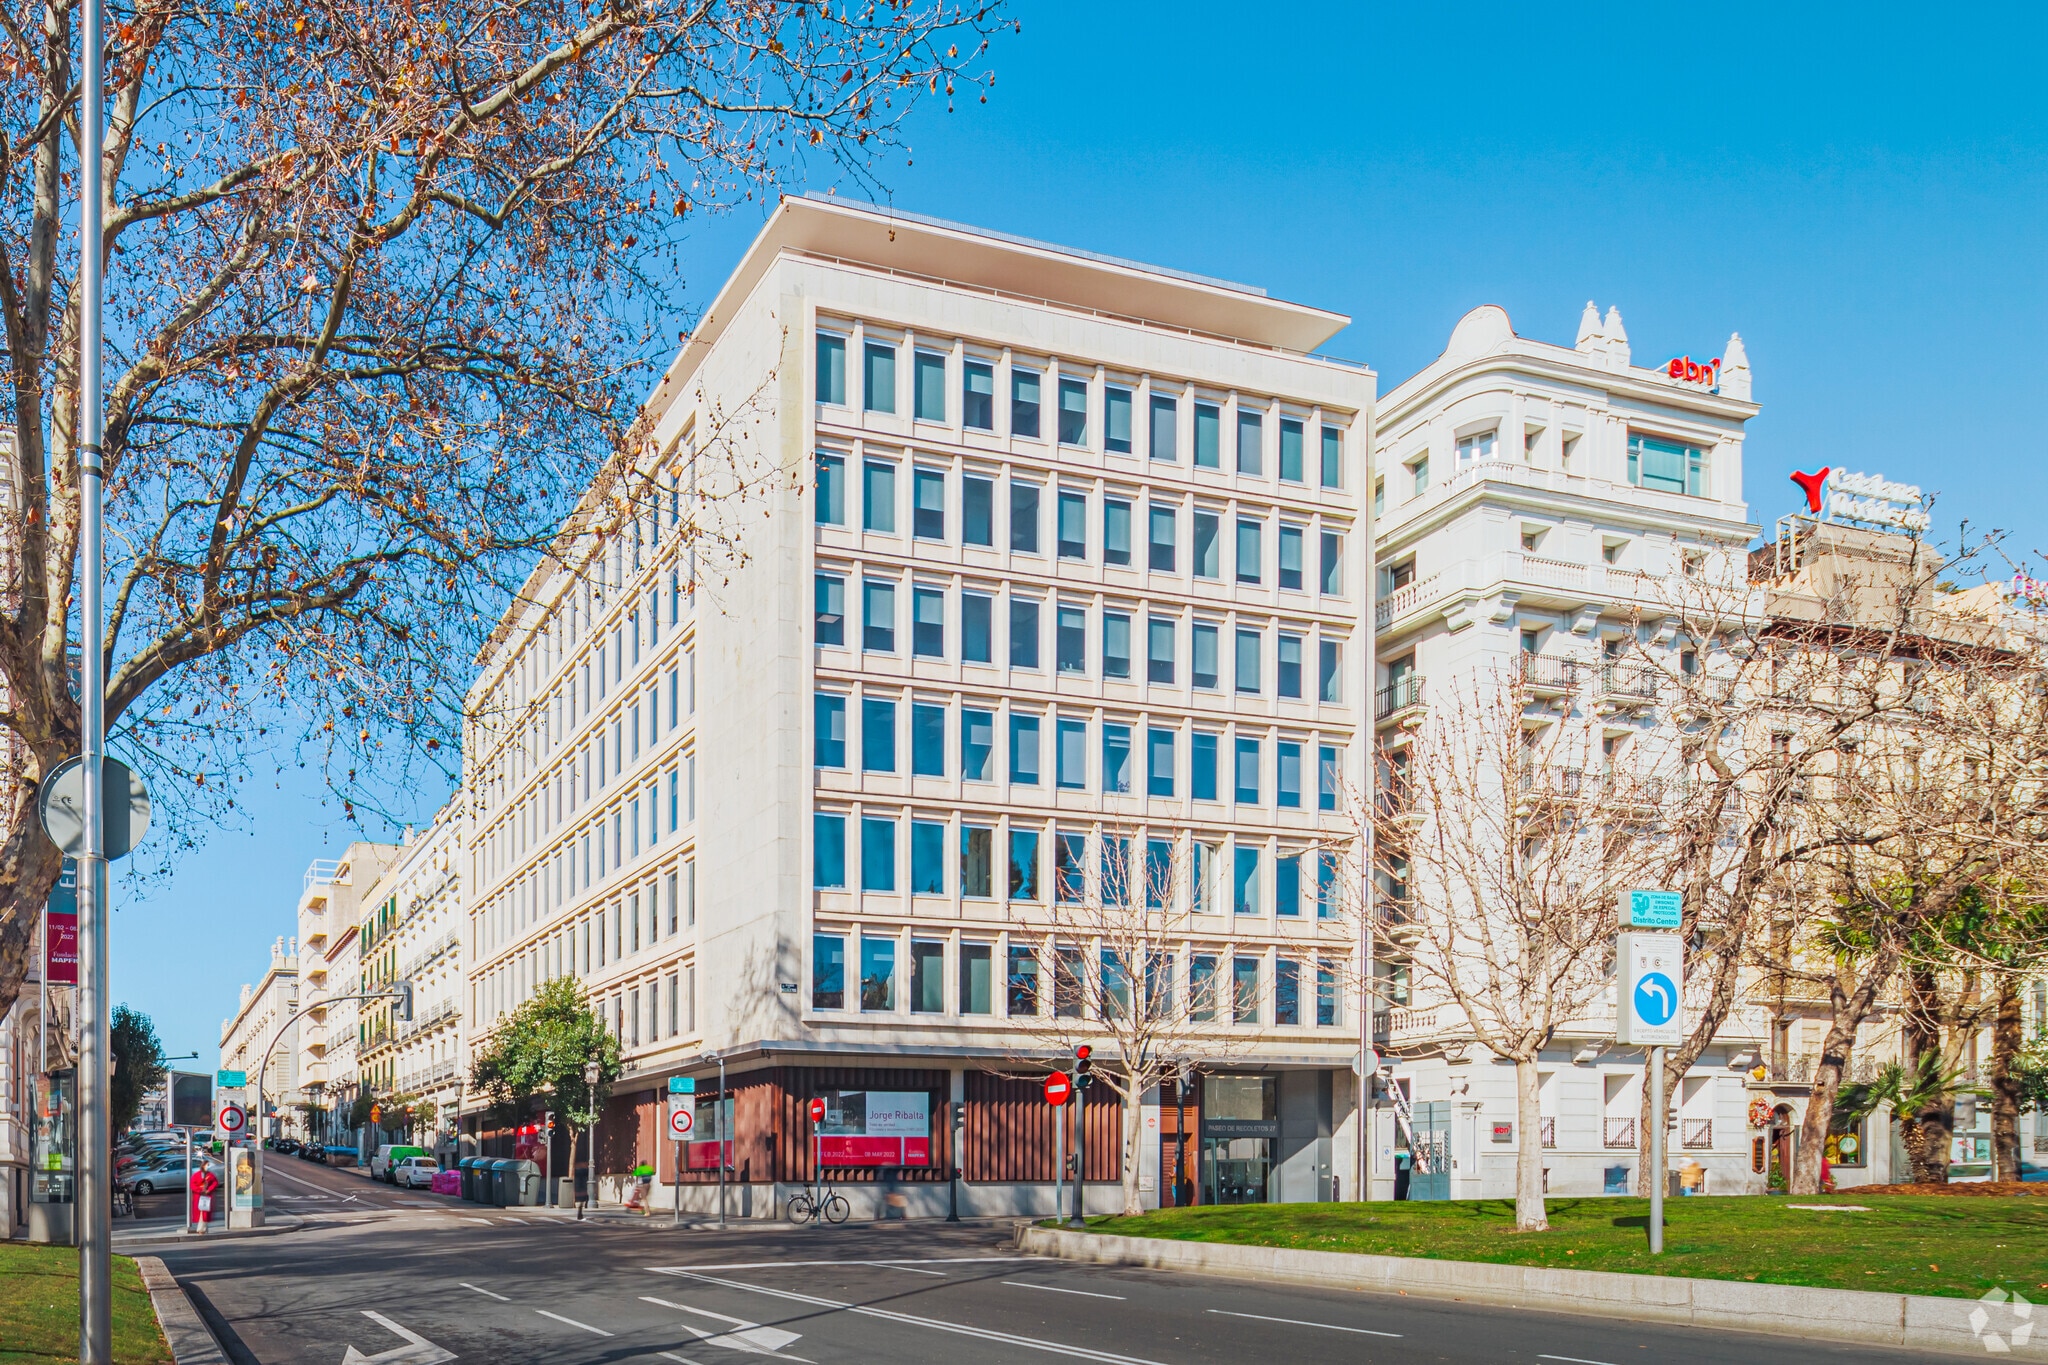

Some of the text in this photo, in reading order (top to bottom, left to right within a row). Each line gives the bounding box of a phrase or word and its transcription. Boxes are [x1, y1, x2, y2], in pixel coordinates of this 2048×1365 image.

[1633, 916, 1678, 925] Distrito Centro
[870, 1110, 924, 1121] Jorge Ribalta
